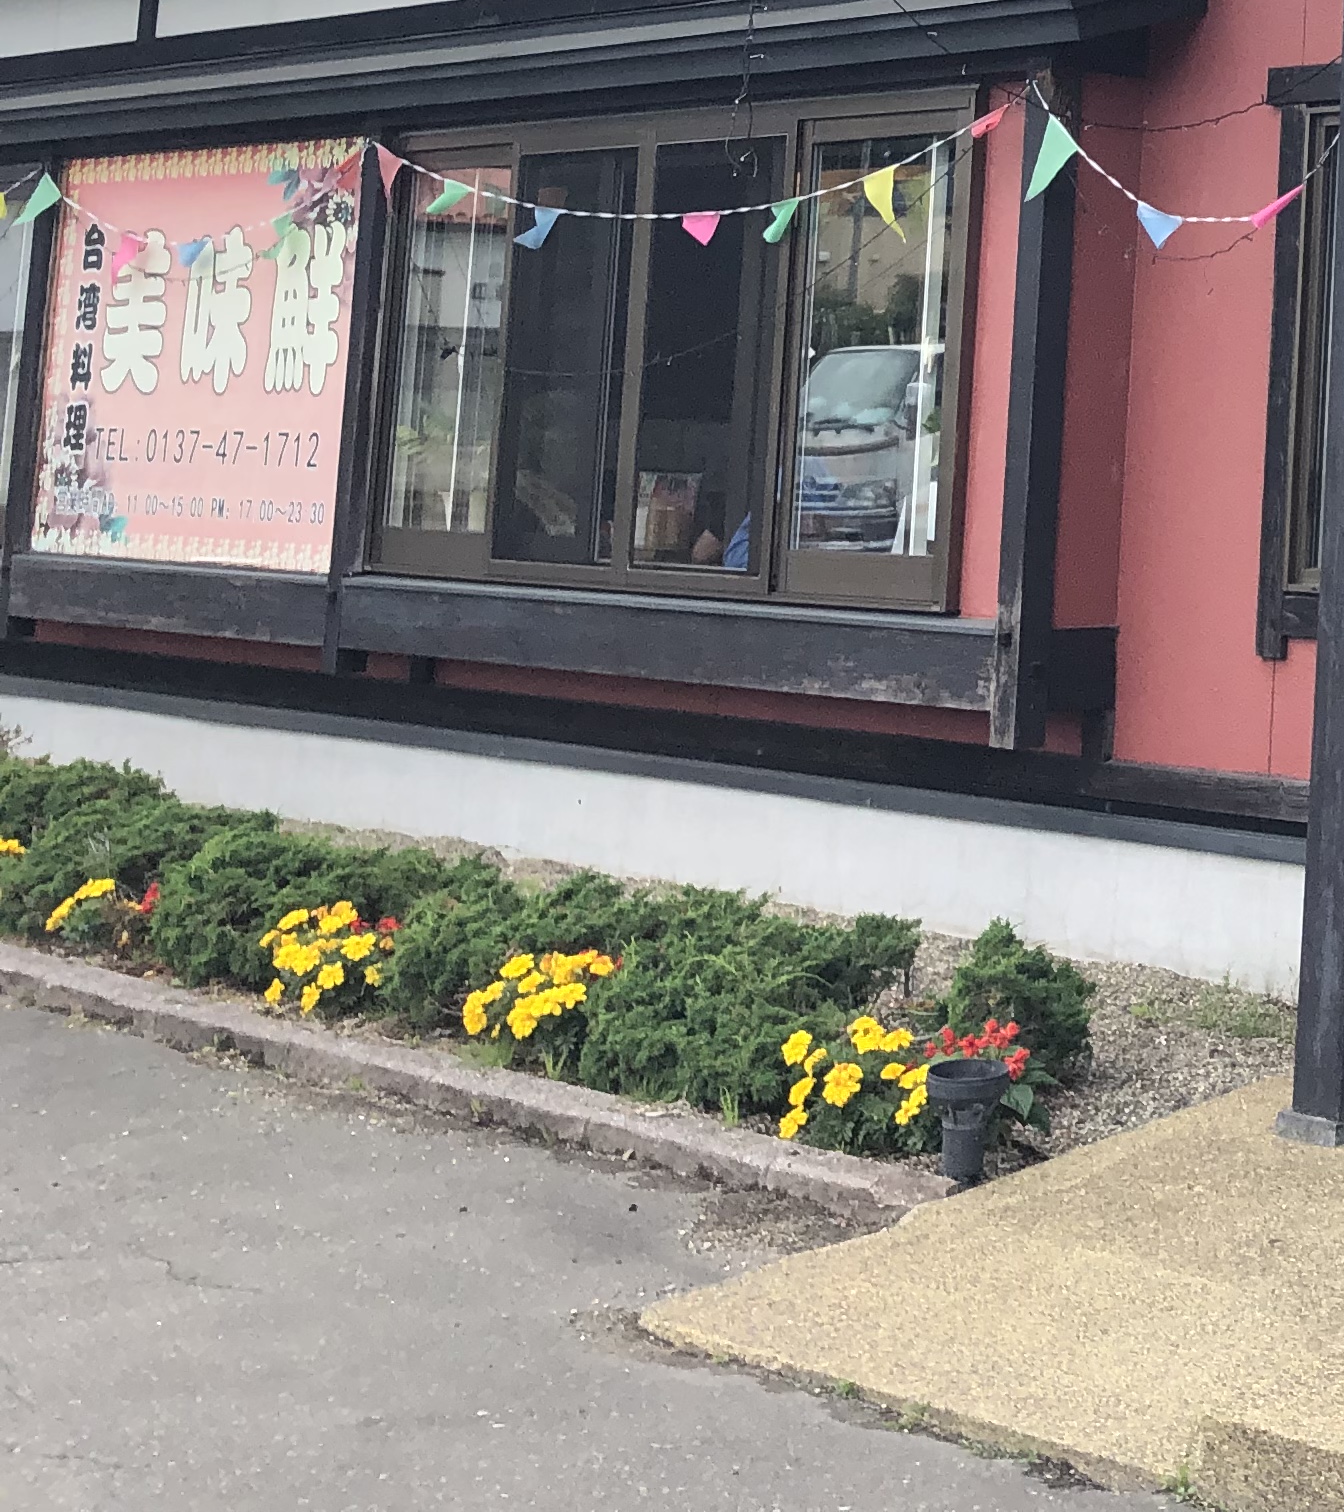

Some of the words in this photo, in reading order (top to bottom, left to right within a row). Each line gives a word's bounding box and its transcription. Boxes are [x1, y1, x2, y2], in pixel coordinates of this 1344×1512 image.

[63, 224, 106, 452] 台湾料理
[100, 221, 347, 396] 美味鮮
